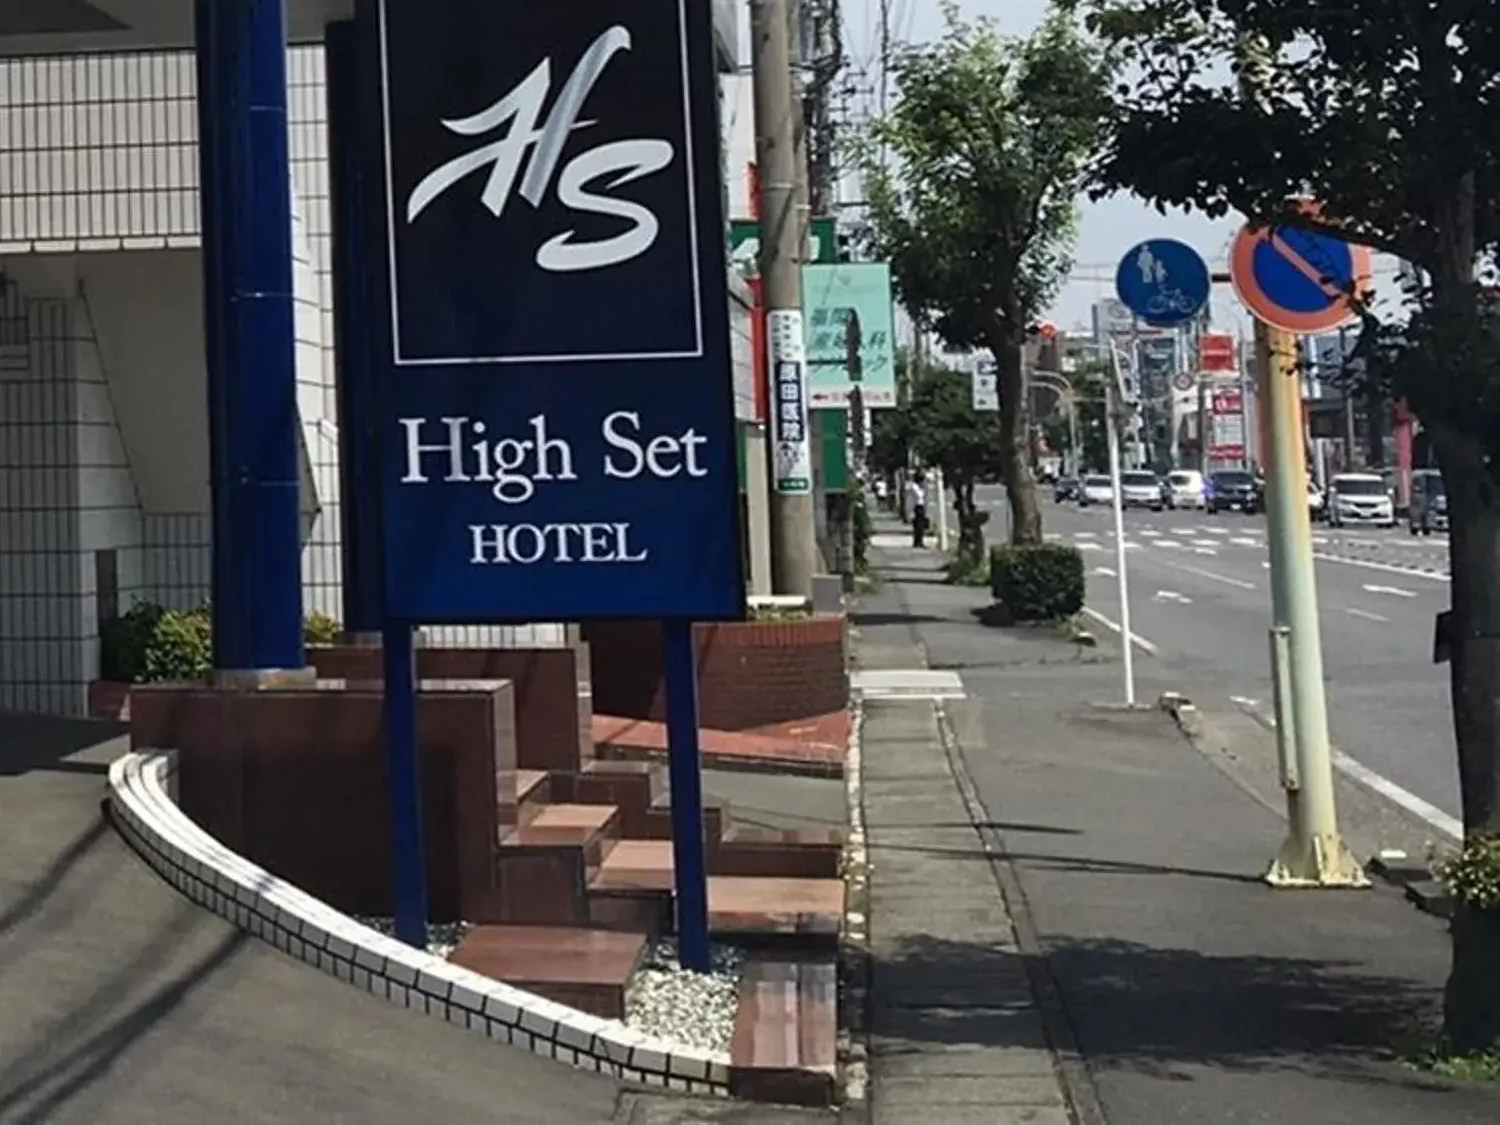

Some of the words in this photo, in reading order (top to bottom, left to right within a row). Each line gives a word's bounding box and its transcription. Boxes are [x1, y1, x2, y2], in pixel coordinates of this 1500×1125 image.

[400, 414, 577, 504] High
[603, 411, 708, 479] Set
[469, 521, 647, 564] HOTEL
